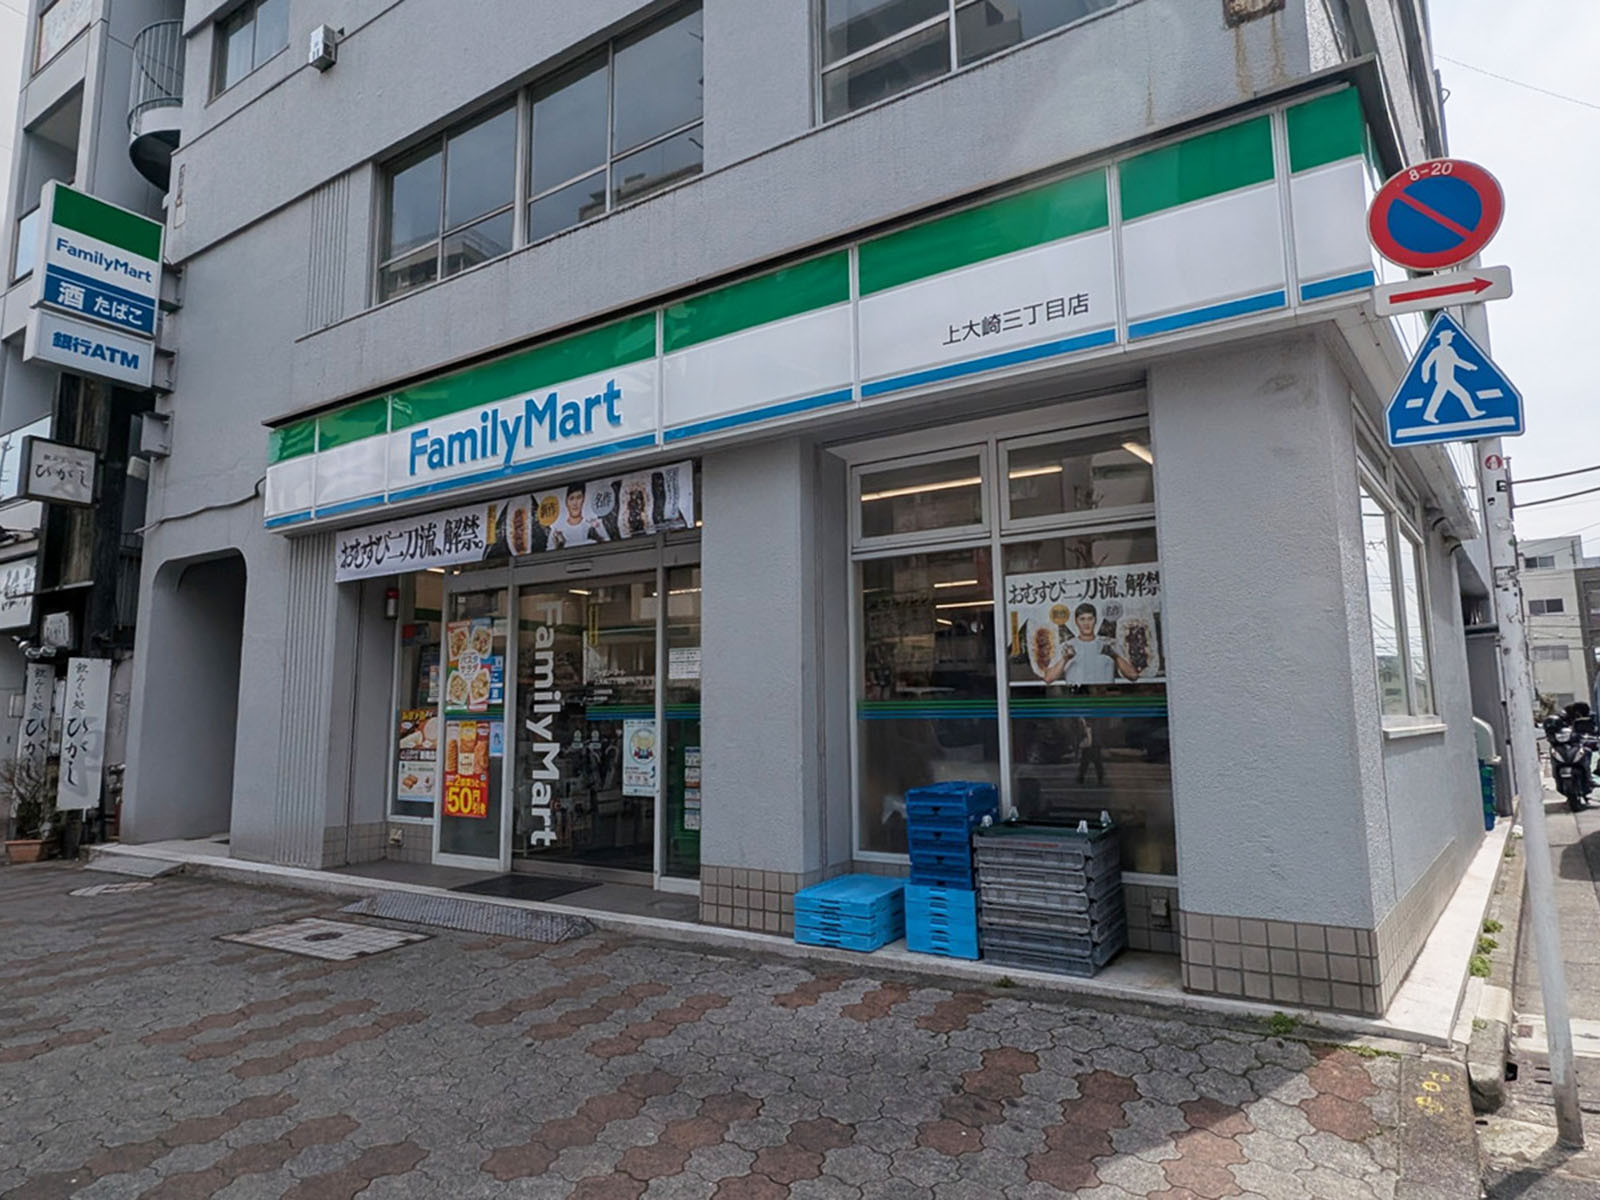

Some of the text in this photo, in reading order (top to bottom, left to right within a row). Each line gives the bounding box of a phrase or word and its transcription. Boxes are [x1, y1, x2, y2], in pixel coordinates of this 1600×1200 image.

[1409, 161, 1453, 181] 8-20
[56, 237, 152, 283] FamilyMart
[57, 281, 143, 325] 酒 たばこ
[942, 293, 1089, 346] 上大崎三丁目店
[52, 331, 139, 369] 銀行ATM
[409, 379, 622, 476] FamilyMart
[340, 514, 484, 570] おむすび二刀流、解禁。
[525, 600, 564, 848] FamilyMart
